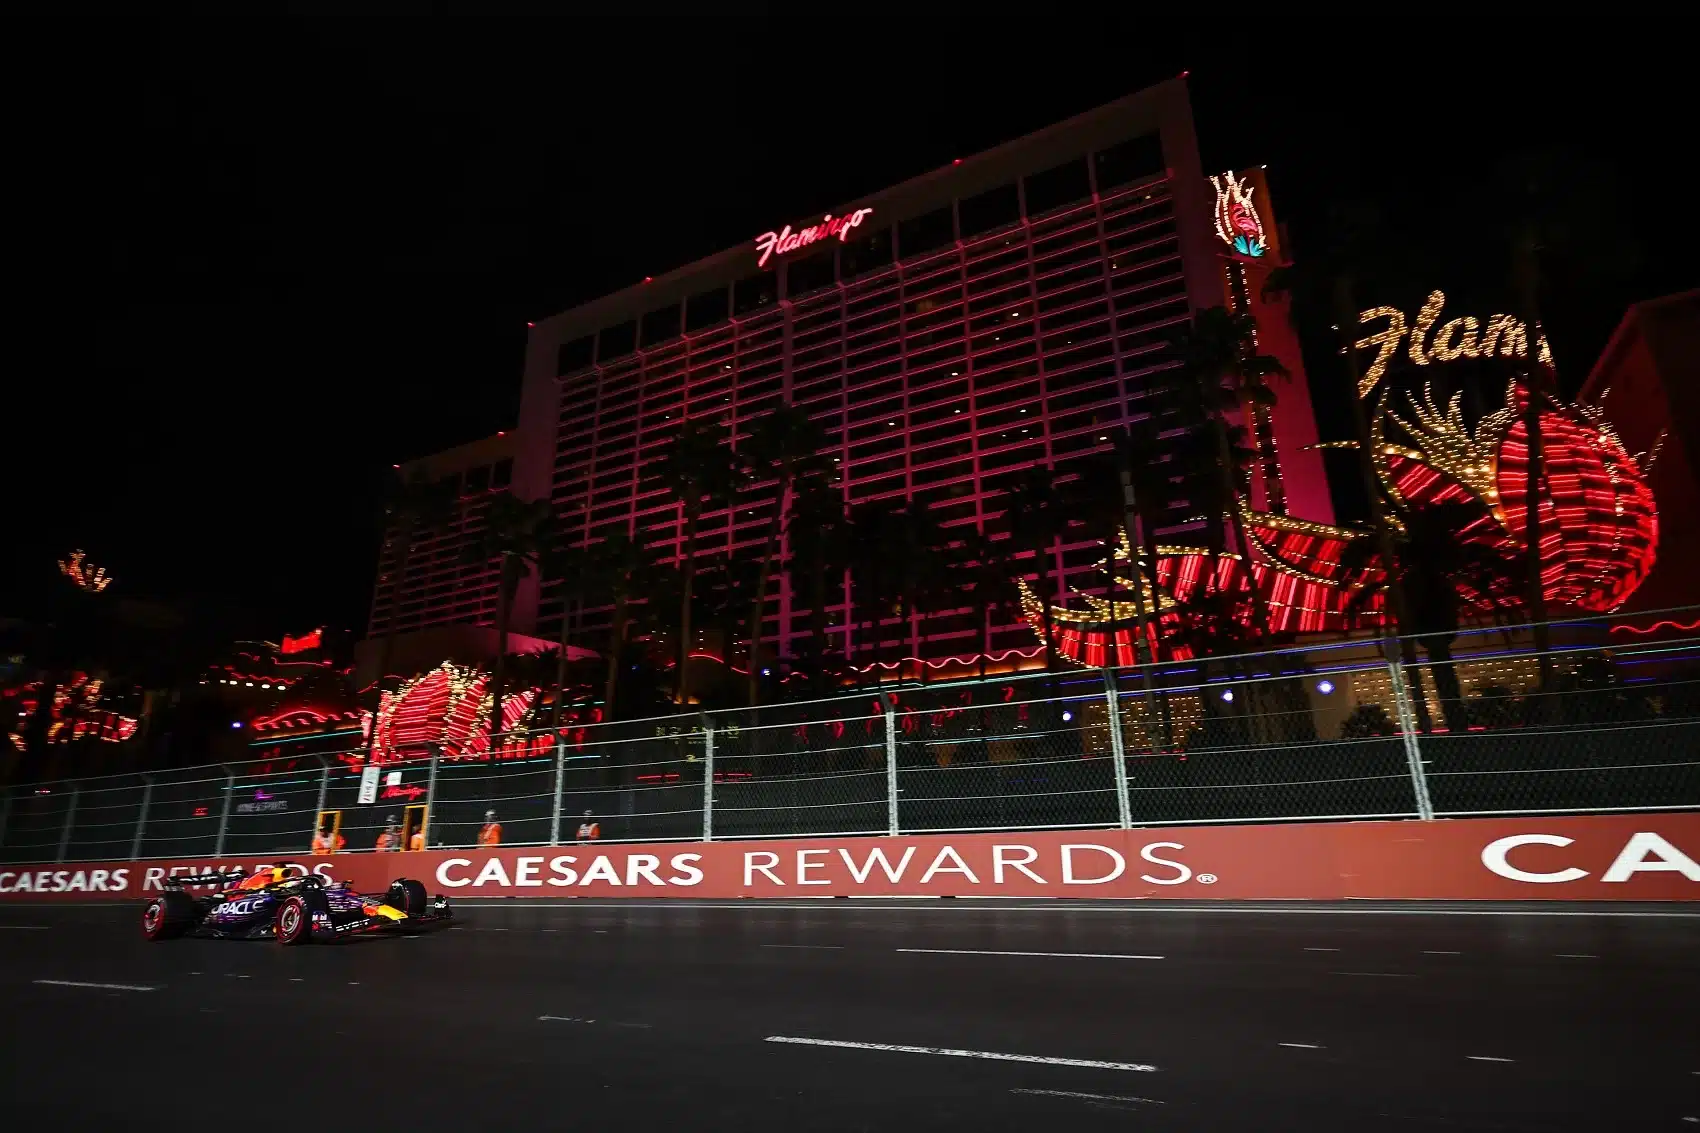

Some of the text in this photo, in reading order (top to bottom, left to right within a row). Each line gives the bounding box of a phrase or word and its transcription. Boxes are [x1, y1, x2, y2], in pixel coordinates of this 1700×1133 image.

[756, 207, 872, 267] Flamingo
[1355, 289, 1555, 399] Flam
[0, 868, 130, 893] CAESARS
[435, 853, 704, 887] CAESARS
[1481, 832, 1700, 883] CA
